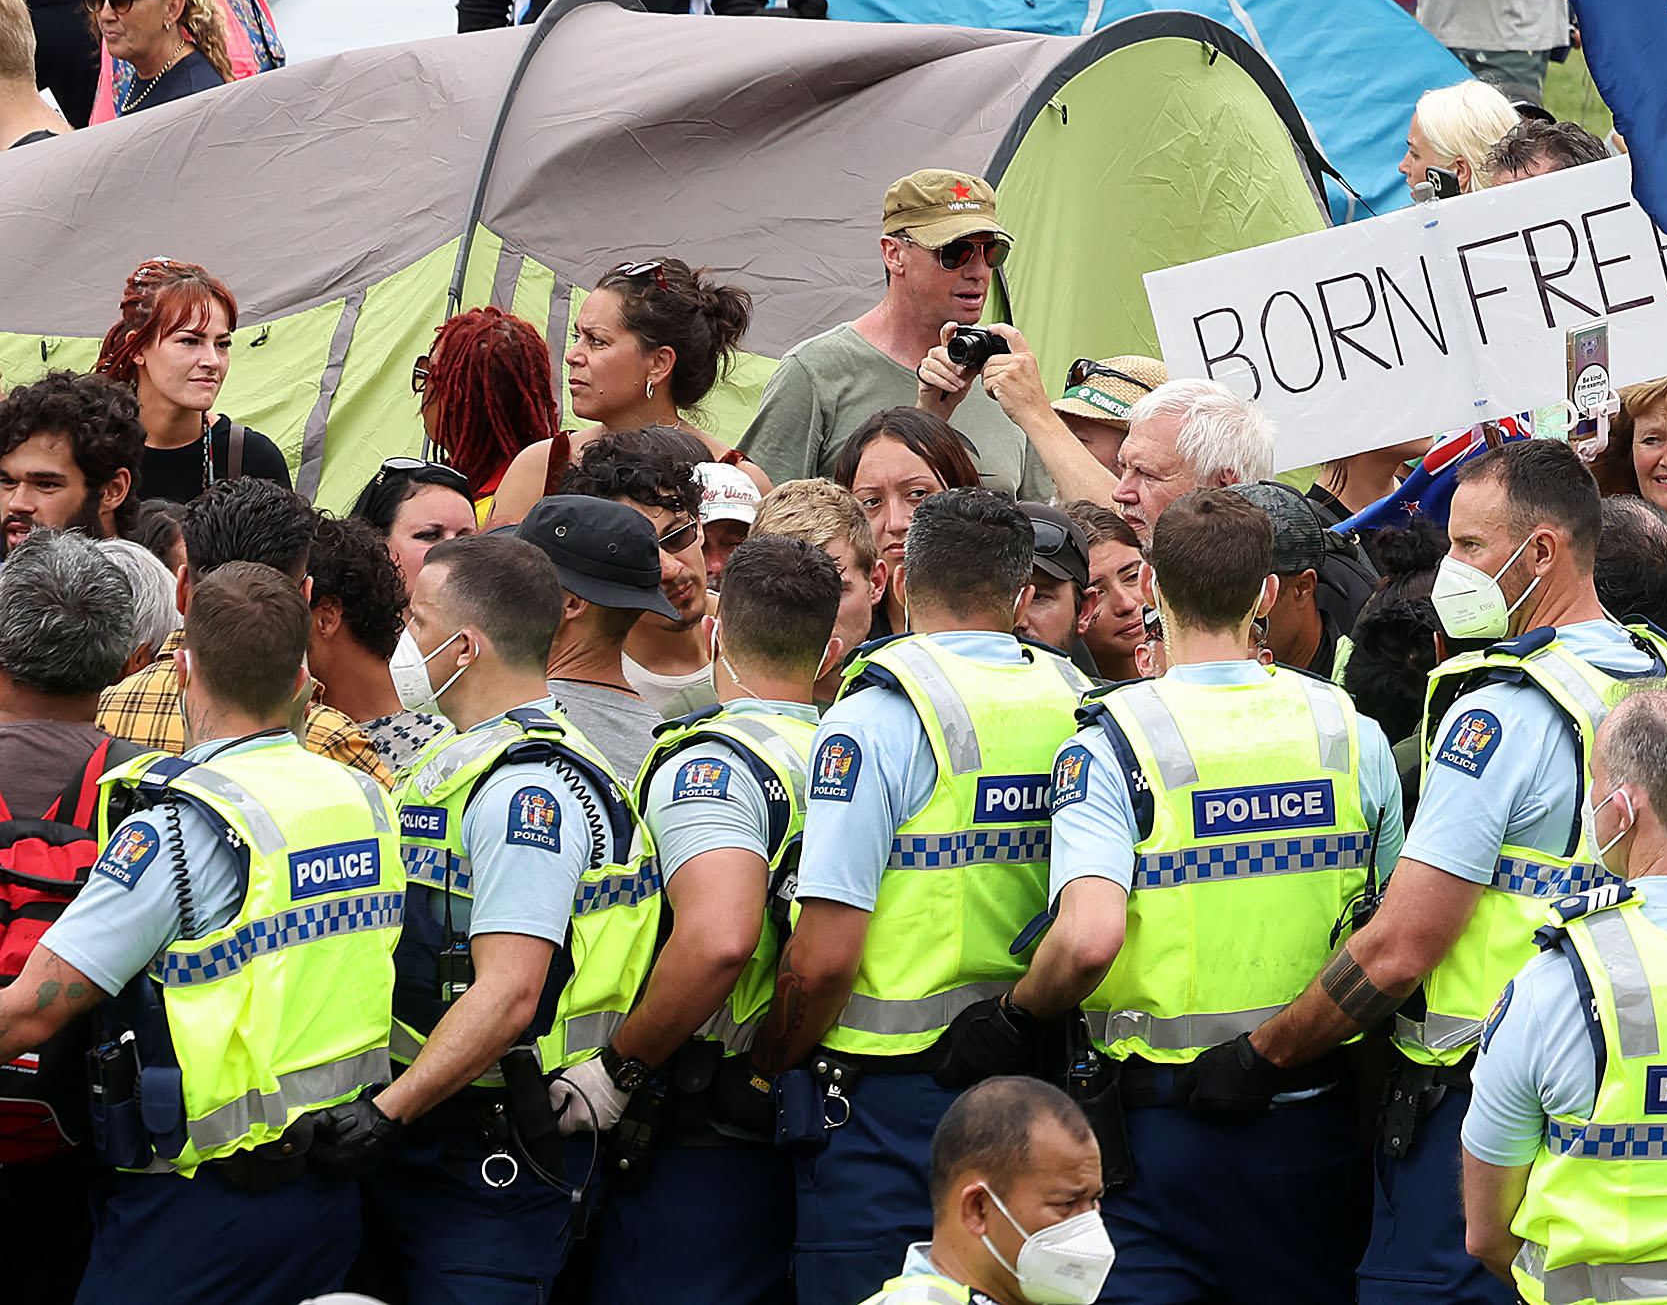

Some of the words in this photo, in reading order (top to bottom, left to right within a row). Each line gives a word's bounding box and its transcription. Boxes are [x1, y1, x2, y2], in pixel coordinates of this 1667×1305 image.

[1193, 253, 1449, 402] BORN
[1582, 376, 1590, 384] Be
[1590, 373, 1602, 382] kind
[1586, 379, 1606, 390] exempt
[1441, 751, 1478, 772] POLICE
[678, 788, 721, 798] POLICE
[813, 785, 848, 797] POLICE
[985, 785, 1051, 812] POLI
[1052, 790, 1082, 810] POLICE
[1204, 790, 1325, 825] POLICE
[513, 830, 556, 847] POLICE
[98, 861, 132, 883] POLICE
[296, 851, 374, 888] POLICE
